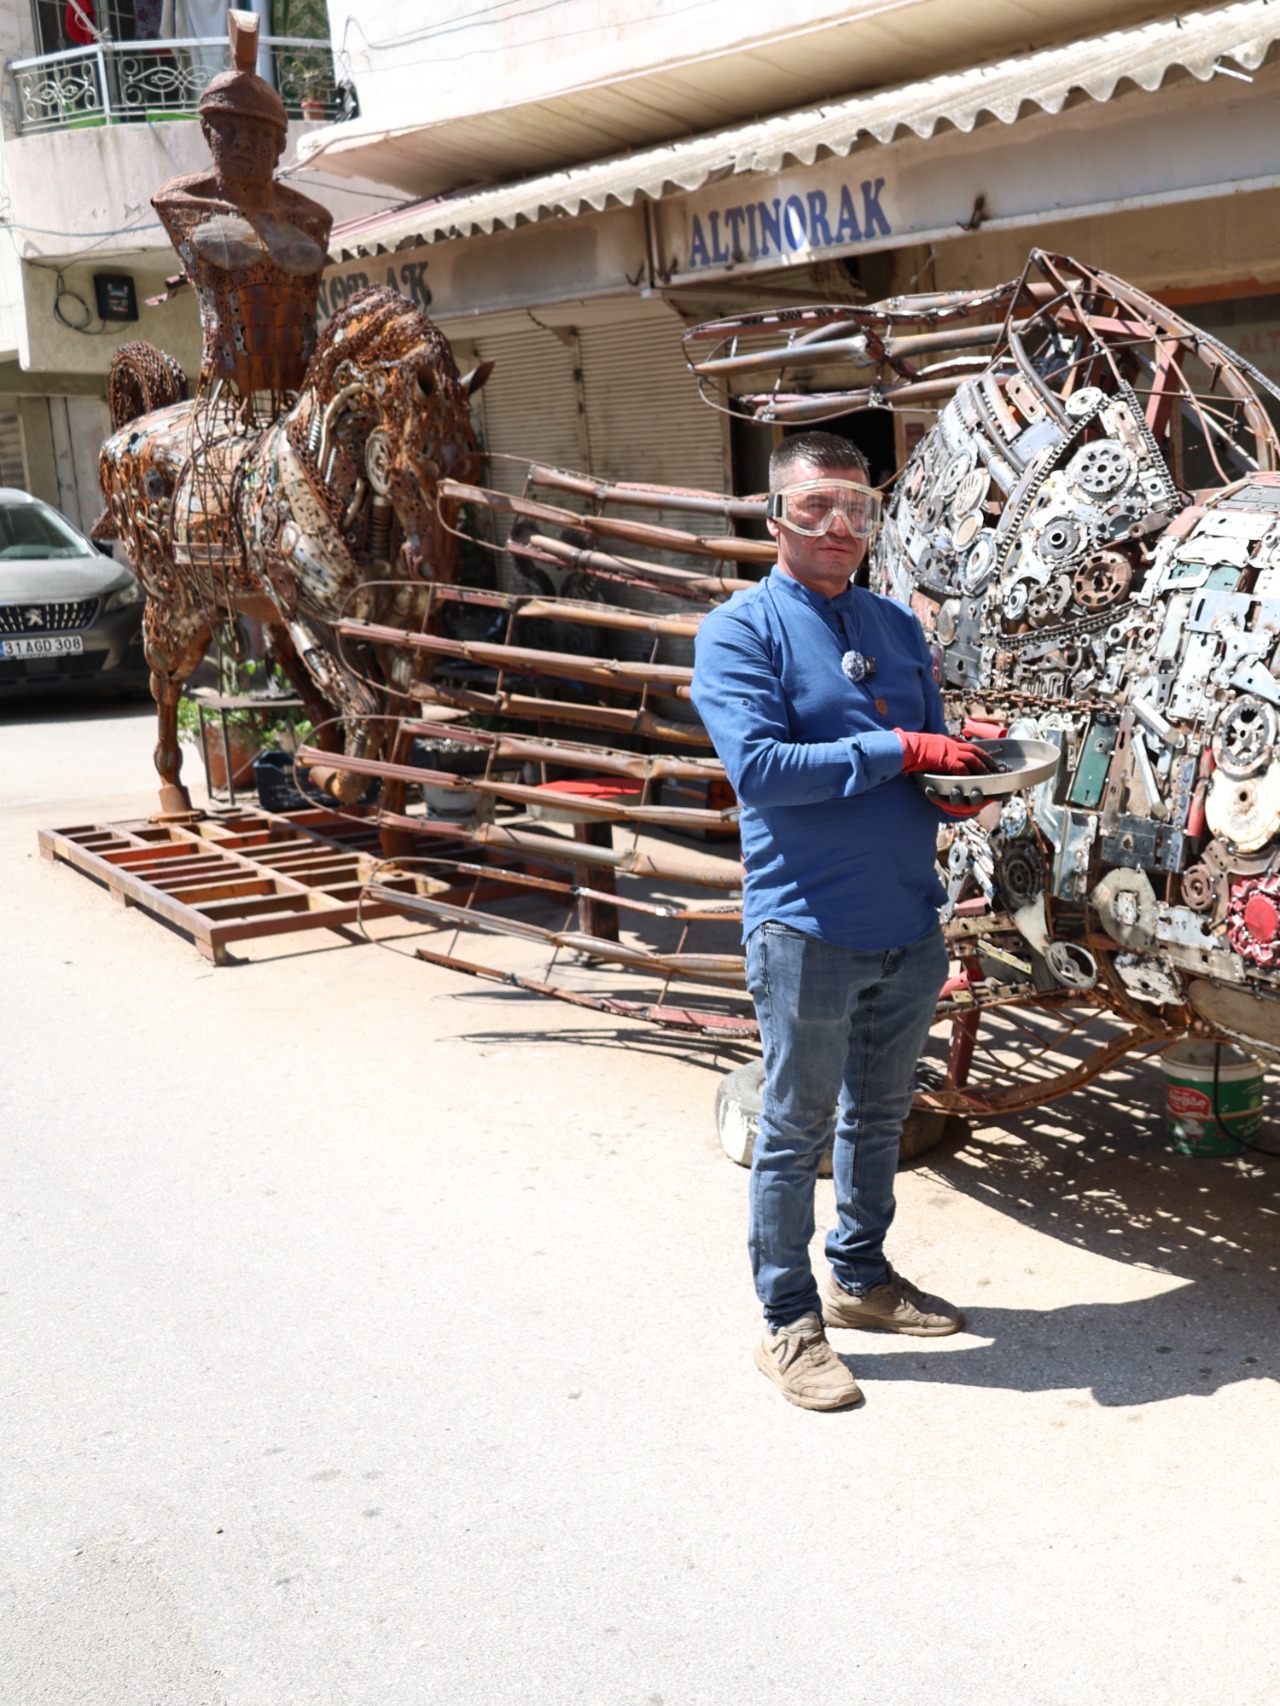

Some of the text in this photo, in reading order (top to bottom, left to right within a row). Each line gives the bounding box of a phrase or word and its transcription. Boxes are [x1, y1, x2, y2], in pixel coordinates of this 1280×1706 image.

[689, 177, 892, 267] ALTINORAK
[5, 637, 81, 655] 31 AGD 308
